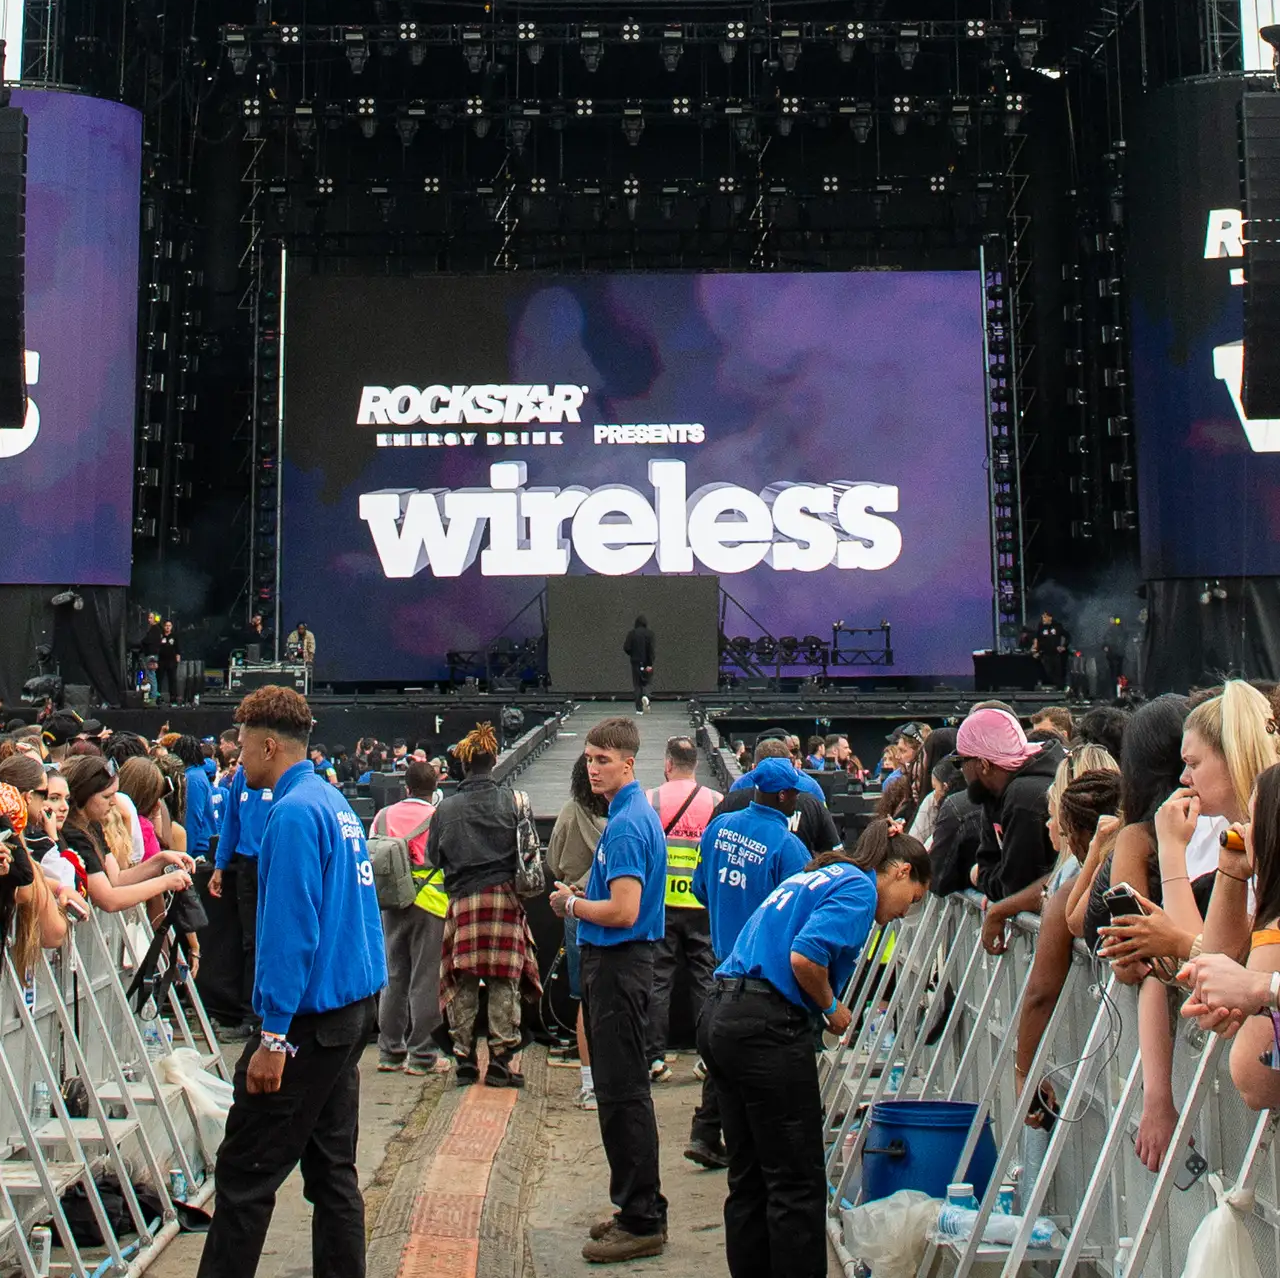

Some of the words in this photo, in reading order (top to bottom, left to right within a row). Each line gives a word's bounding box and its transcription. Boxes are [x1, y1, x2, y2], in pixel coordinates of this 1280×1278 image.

[356, 384, 585, 426] ROCKSTAR
[376, 432, 478, 447] ENERGY
[486, 432, 565, 446] DRINK
[593, 423, 705, 444] PRESENTS
[359, 458, 903, 579] wireless
[717, 827, 768, 855] SPECIALIZED
